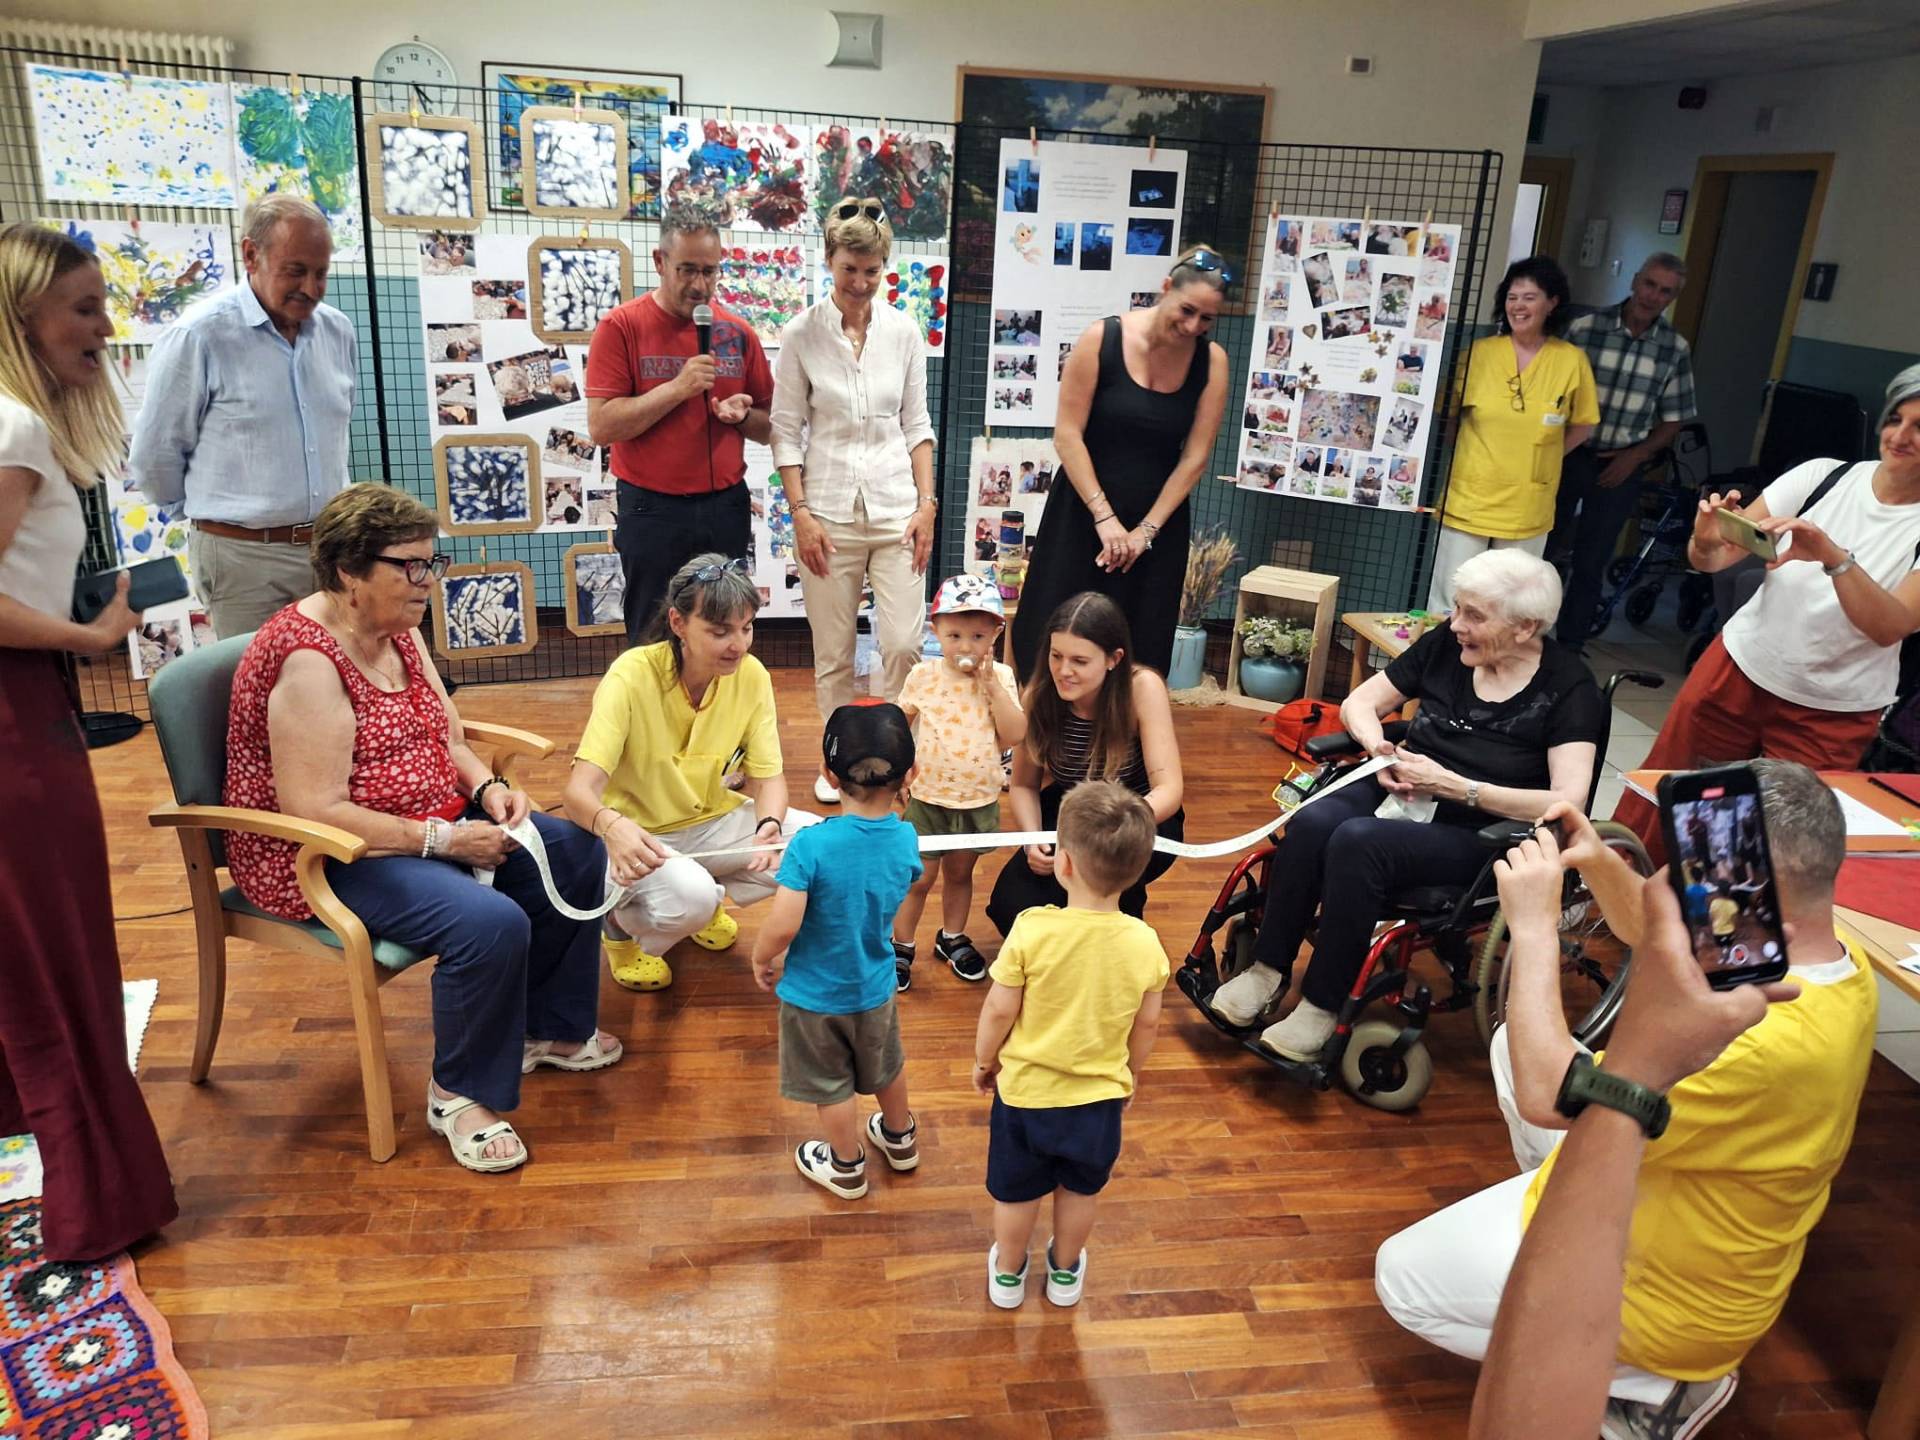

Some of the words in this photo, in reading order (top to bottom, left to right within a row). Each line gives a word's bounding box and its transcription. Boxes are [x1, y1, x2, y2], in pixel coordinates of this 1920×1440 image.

[395, 56, 404, 64] 11
[410, 53, 419, 61] 12
[386, 66, 395, 74] 10
